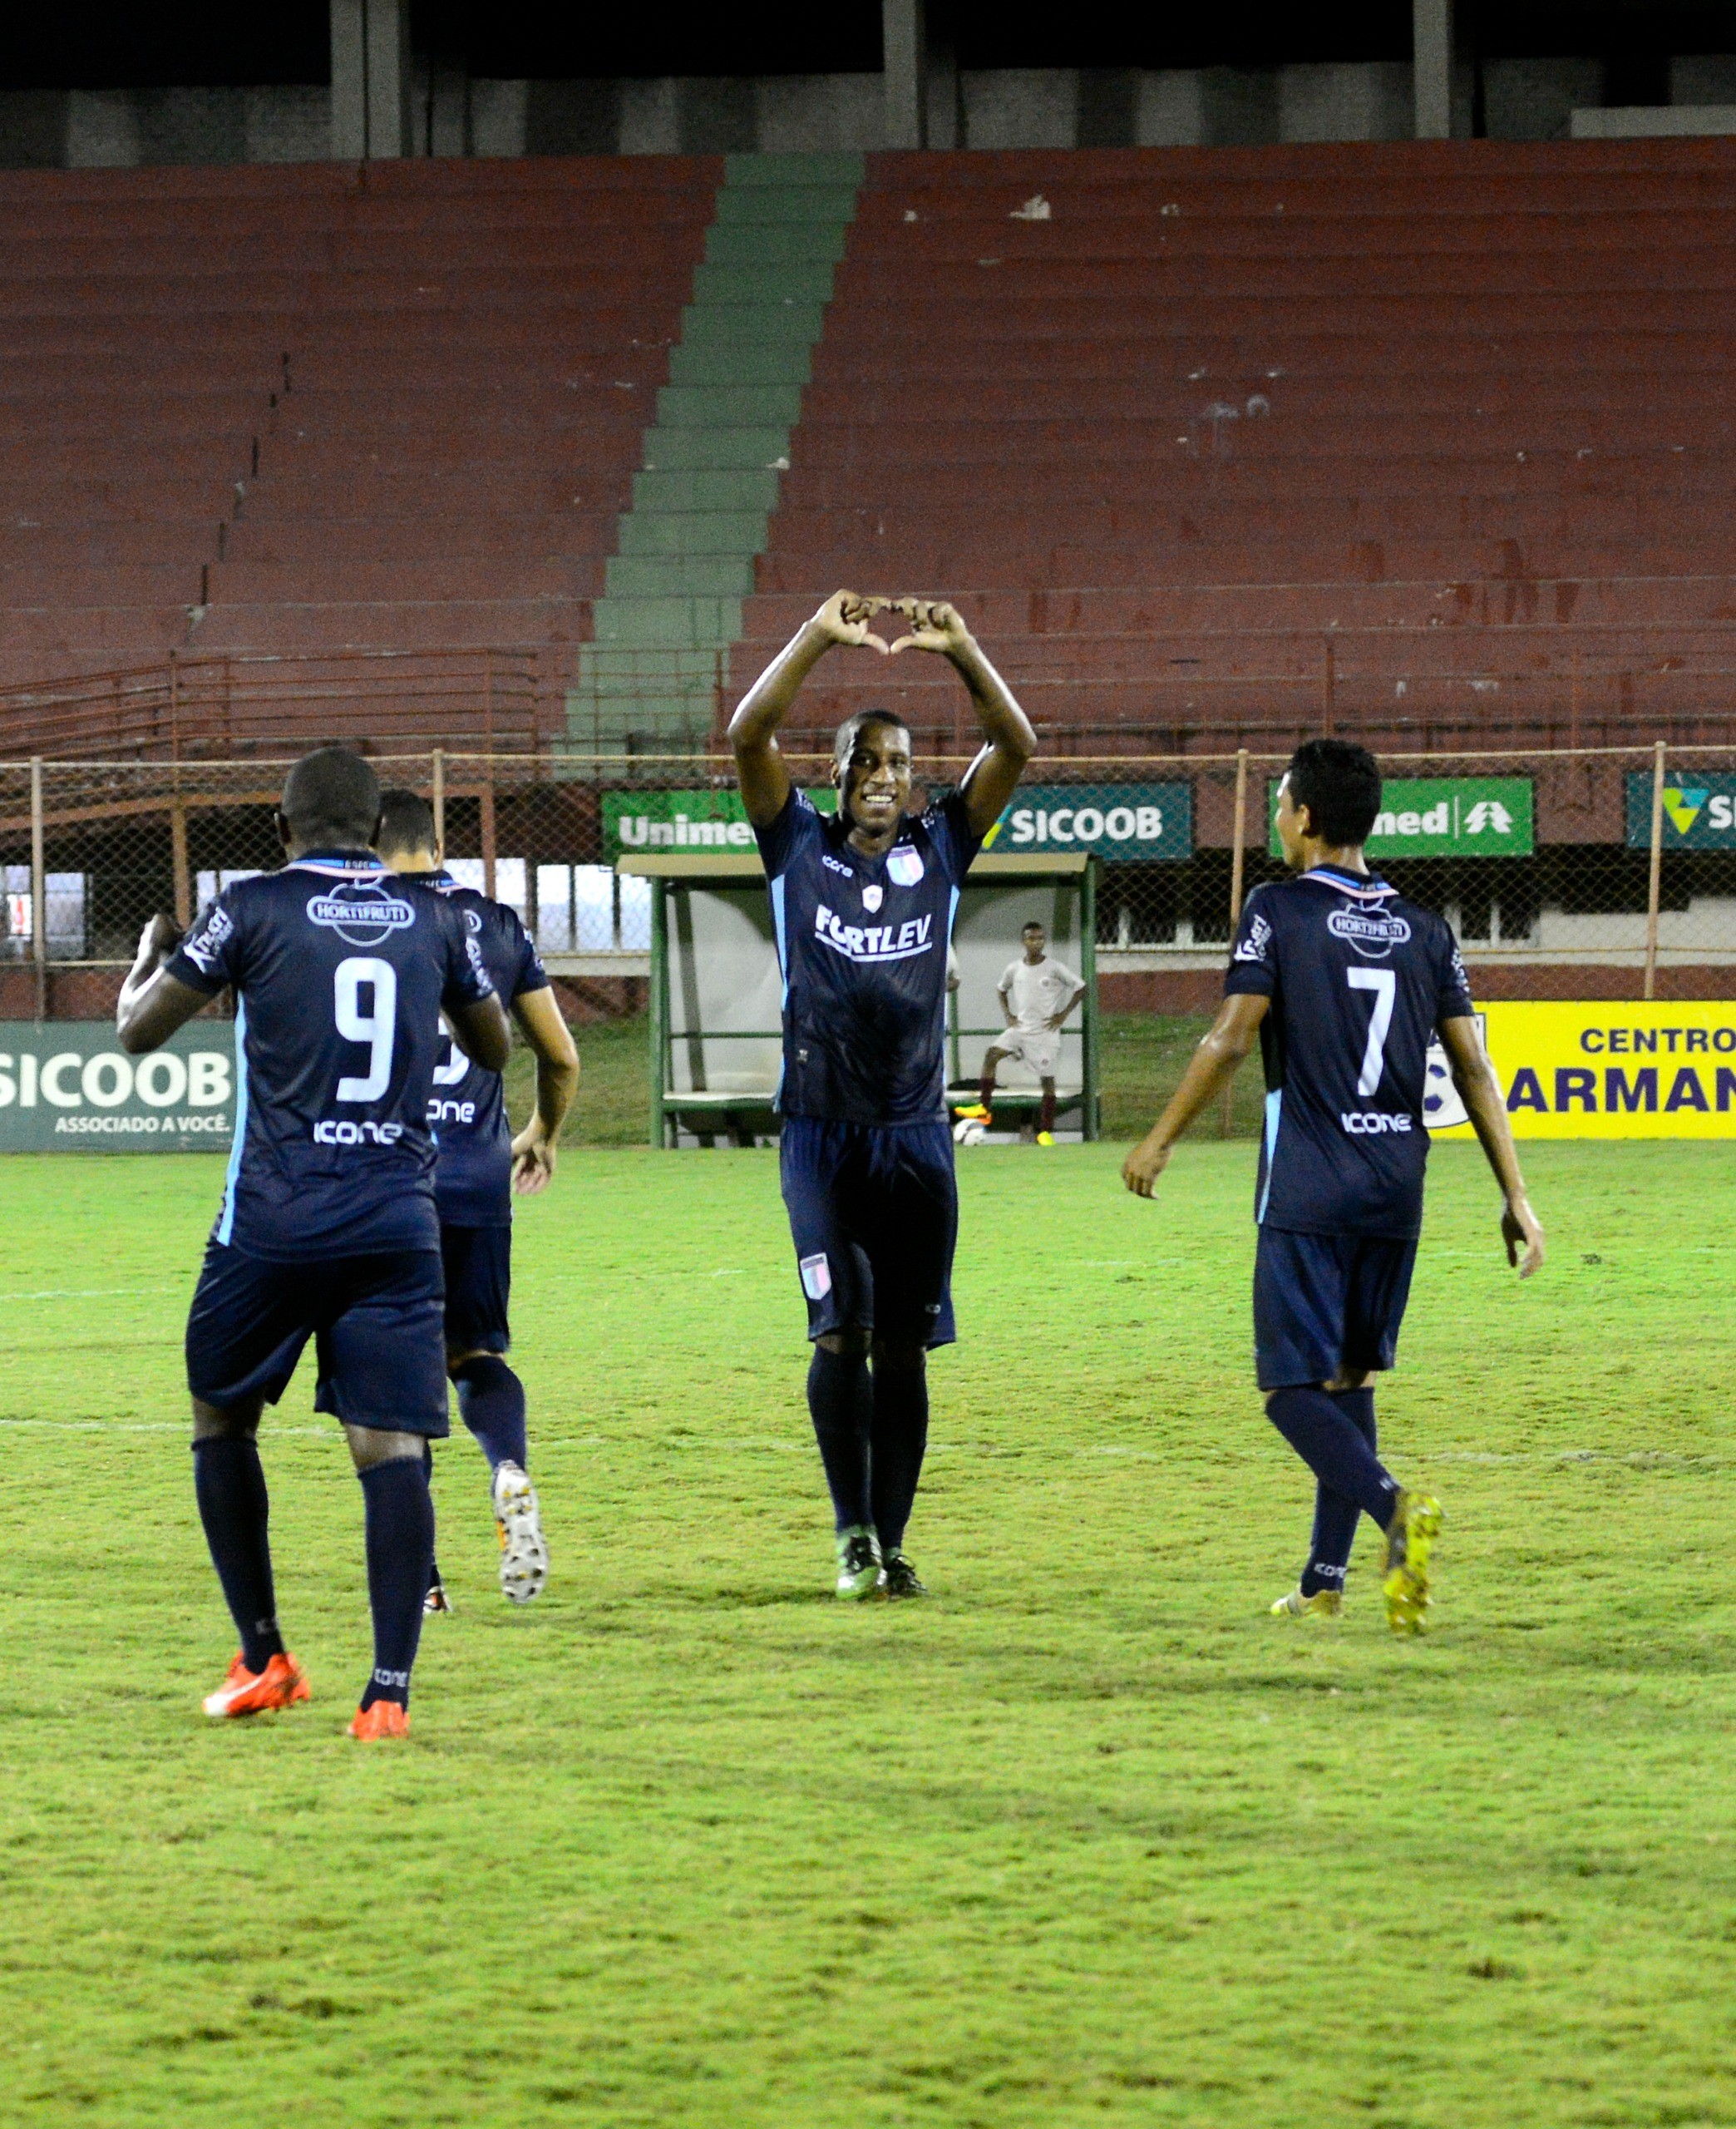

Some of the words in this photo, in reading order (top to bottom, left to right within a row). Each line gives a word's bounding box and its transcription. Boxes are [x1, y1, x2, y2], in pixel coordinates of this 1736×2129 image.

[619, 806, 759, 847] Unime
[1011, 806, 1163, 843] SICOOB
[1371, 801, 1449, 836] med
[1709, 794, 1736, 830] S
[317, 902, 406, 921] HORTIFRUTI
[815, 904, 933, 954] FORTLEV
[334, 956, 397, 1102] 9
[1346, 966, 1396, 1096] 7
[1579, 1027, 1736, 1054] CENTRO
[55, 1116, 159, 1134] ASSOCIADO
[162, 1117, 177, 1133] A
[177, 1114, 231, 1133] VOCÊ.
